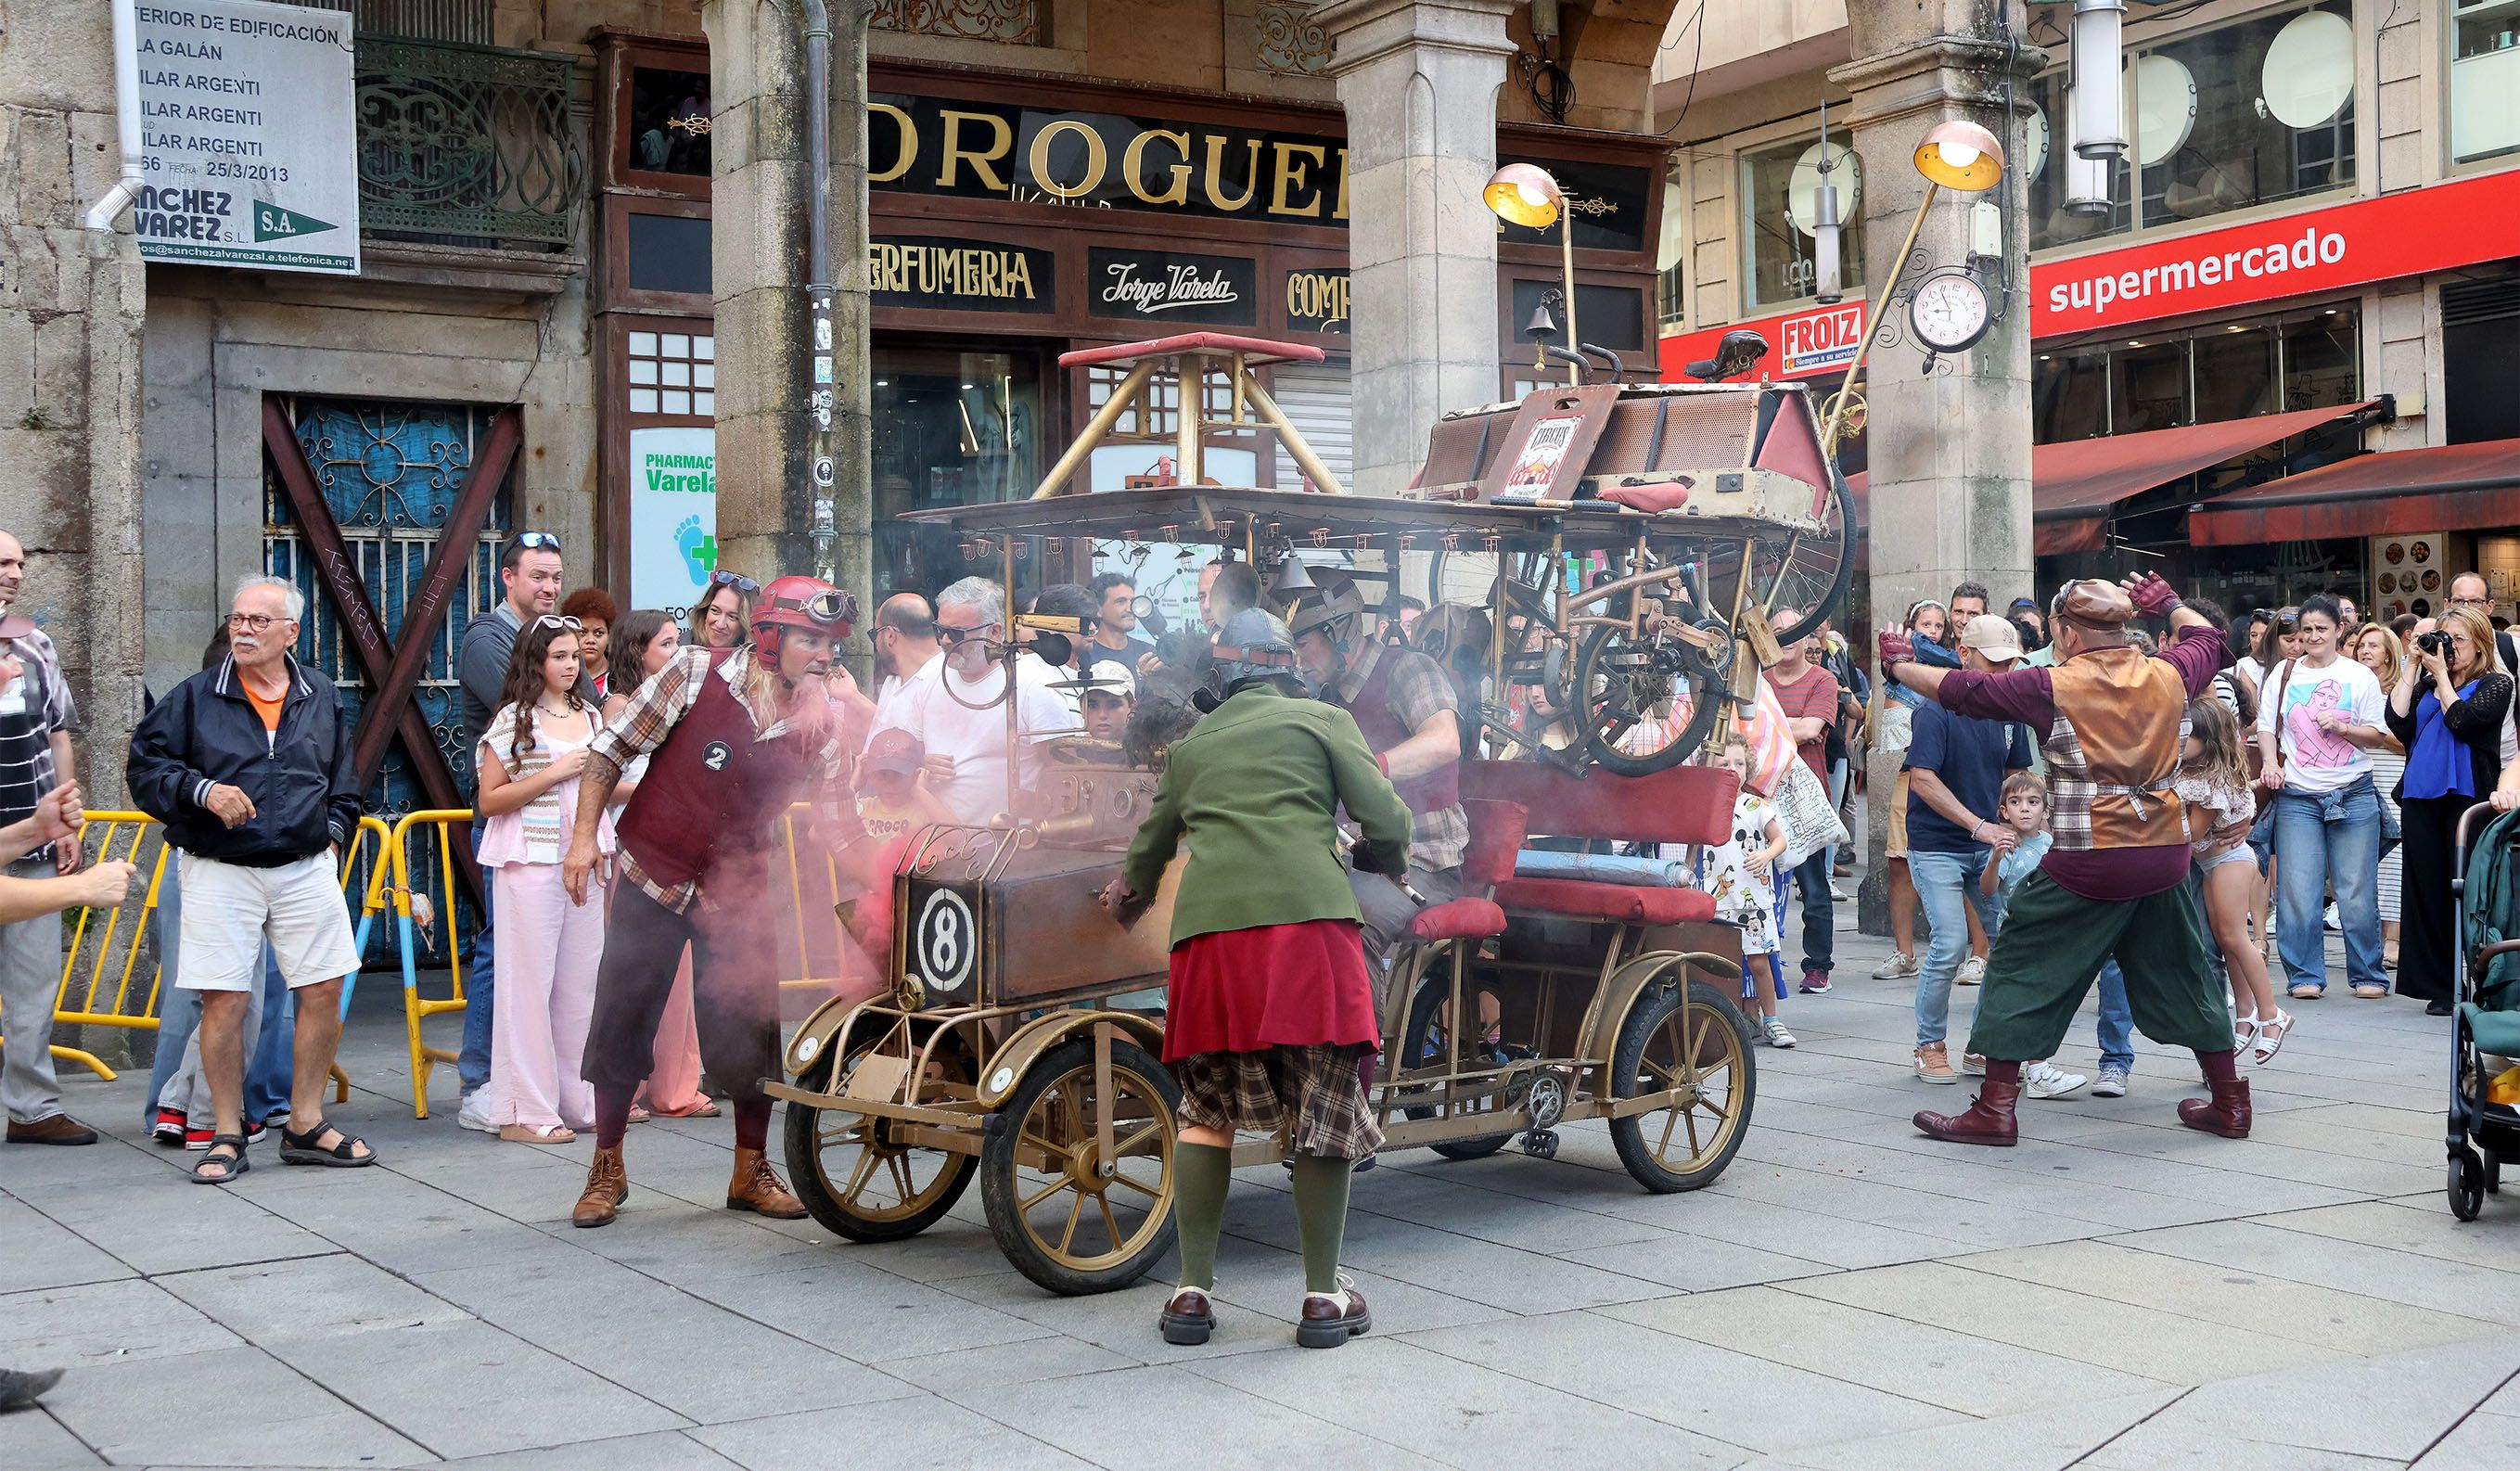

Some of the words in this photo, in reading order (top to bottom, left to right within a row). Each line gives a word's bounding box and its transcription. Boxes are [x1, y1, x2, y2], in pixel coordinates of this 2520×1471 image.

[134, 6, 195, 28] ERIOR
[201, 15, 224, 32] DE
[230, 19, 339, 45] EDIFICACIÓN
[160, 41, 222, 61] GALÁN
[185, 74, 260, 96] ARGENTI
[186, 105, 262, 126] ARGENTI
[187, 136, 262, 157] ARGENTI
[207, 161, 288, 182] 25/3/2013
[134, 185, 232, 216] NCHEZ
[262, 210, 296, 234] S.A.
[2049, 227, 2347, 314] supermercado
[1102, 262, 1167, 312] Jorge
[1167, 264, 1238, 303] Varela
[1784, 310, 1859, 356] FROIZ
[1530, 426, 1570, 449] CIRCUS
[646, 454, 715, 469] PHARMAC
[705, 747, 727, 771] 2
[932, 906, 958, 973] 8
